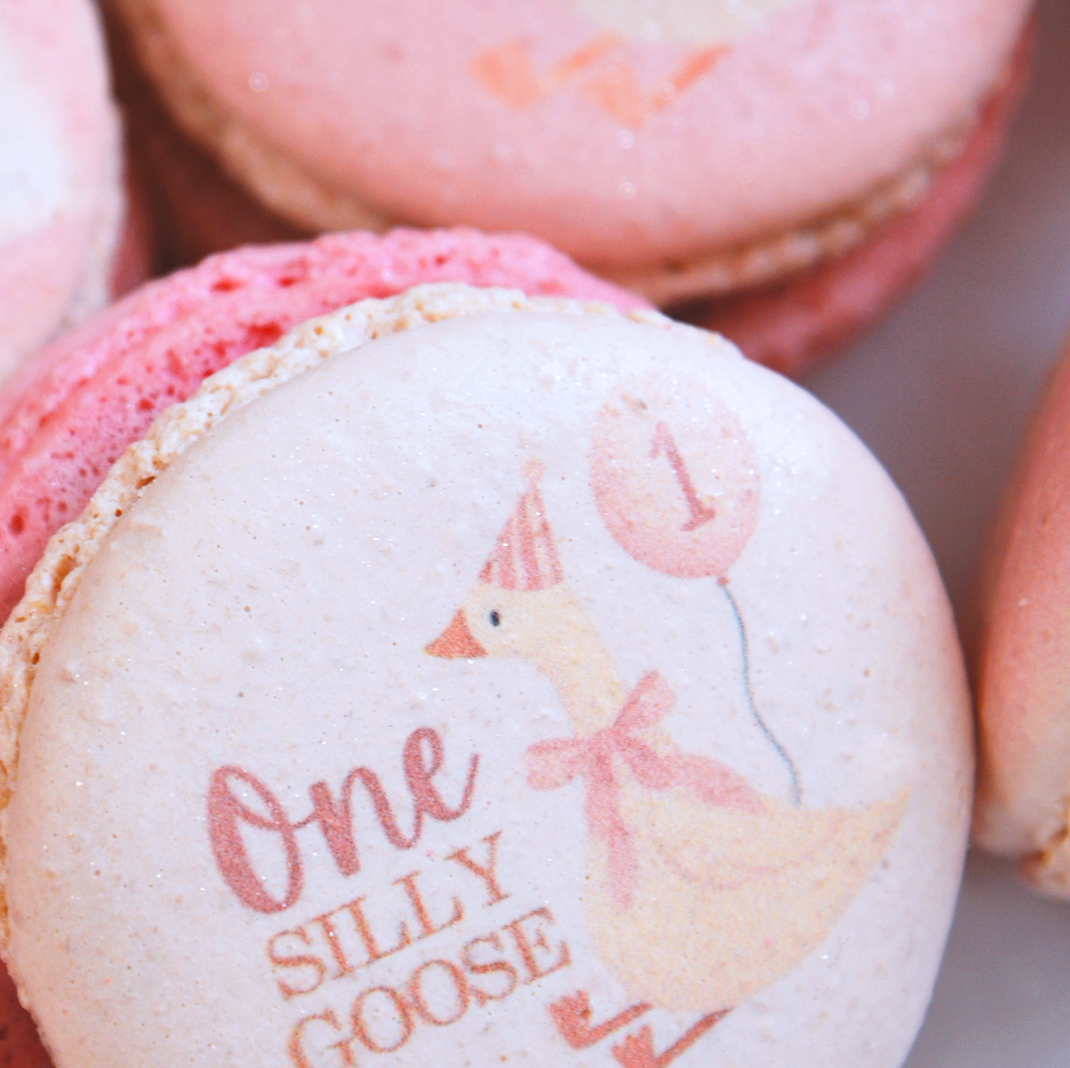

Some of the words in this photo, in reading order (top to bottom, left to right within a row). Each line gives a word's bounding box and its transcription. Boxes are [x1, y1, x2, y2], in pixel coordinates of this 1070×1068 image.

[648, 419, 717, 532] 1
[206, 725, 481, 915] One
[266, 831, 511, 999] SILLY
